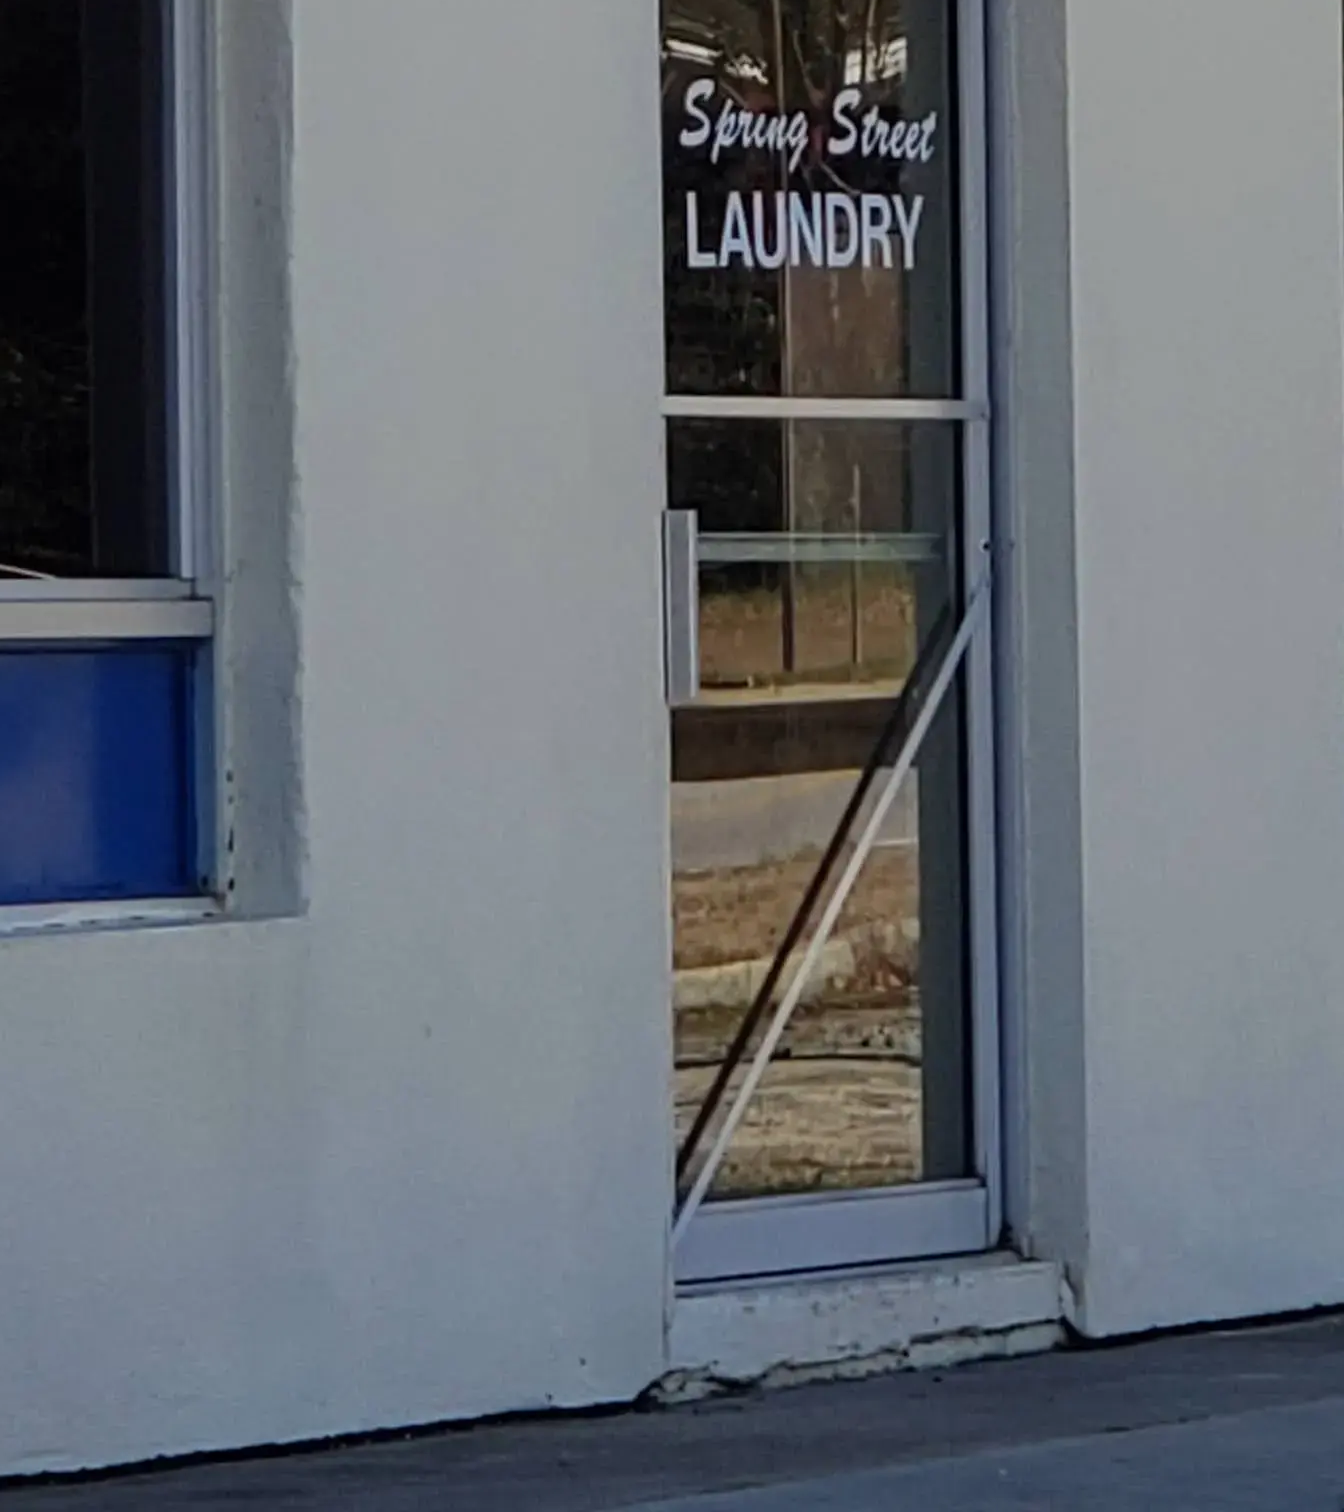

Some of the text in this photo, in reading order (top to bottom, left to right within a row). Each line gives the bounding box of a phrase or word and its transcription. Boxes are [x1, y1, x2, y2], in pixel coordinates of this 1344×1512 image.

[679, 78, 937, 173] Spring Street
[686, 190, 924, 270] LAUNDRY
